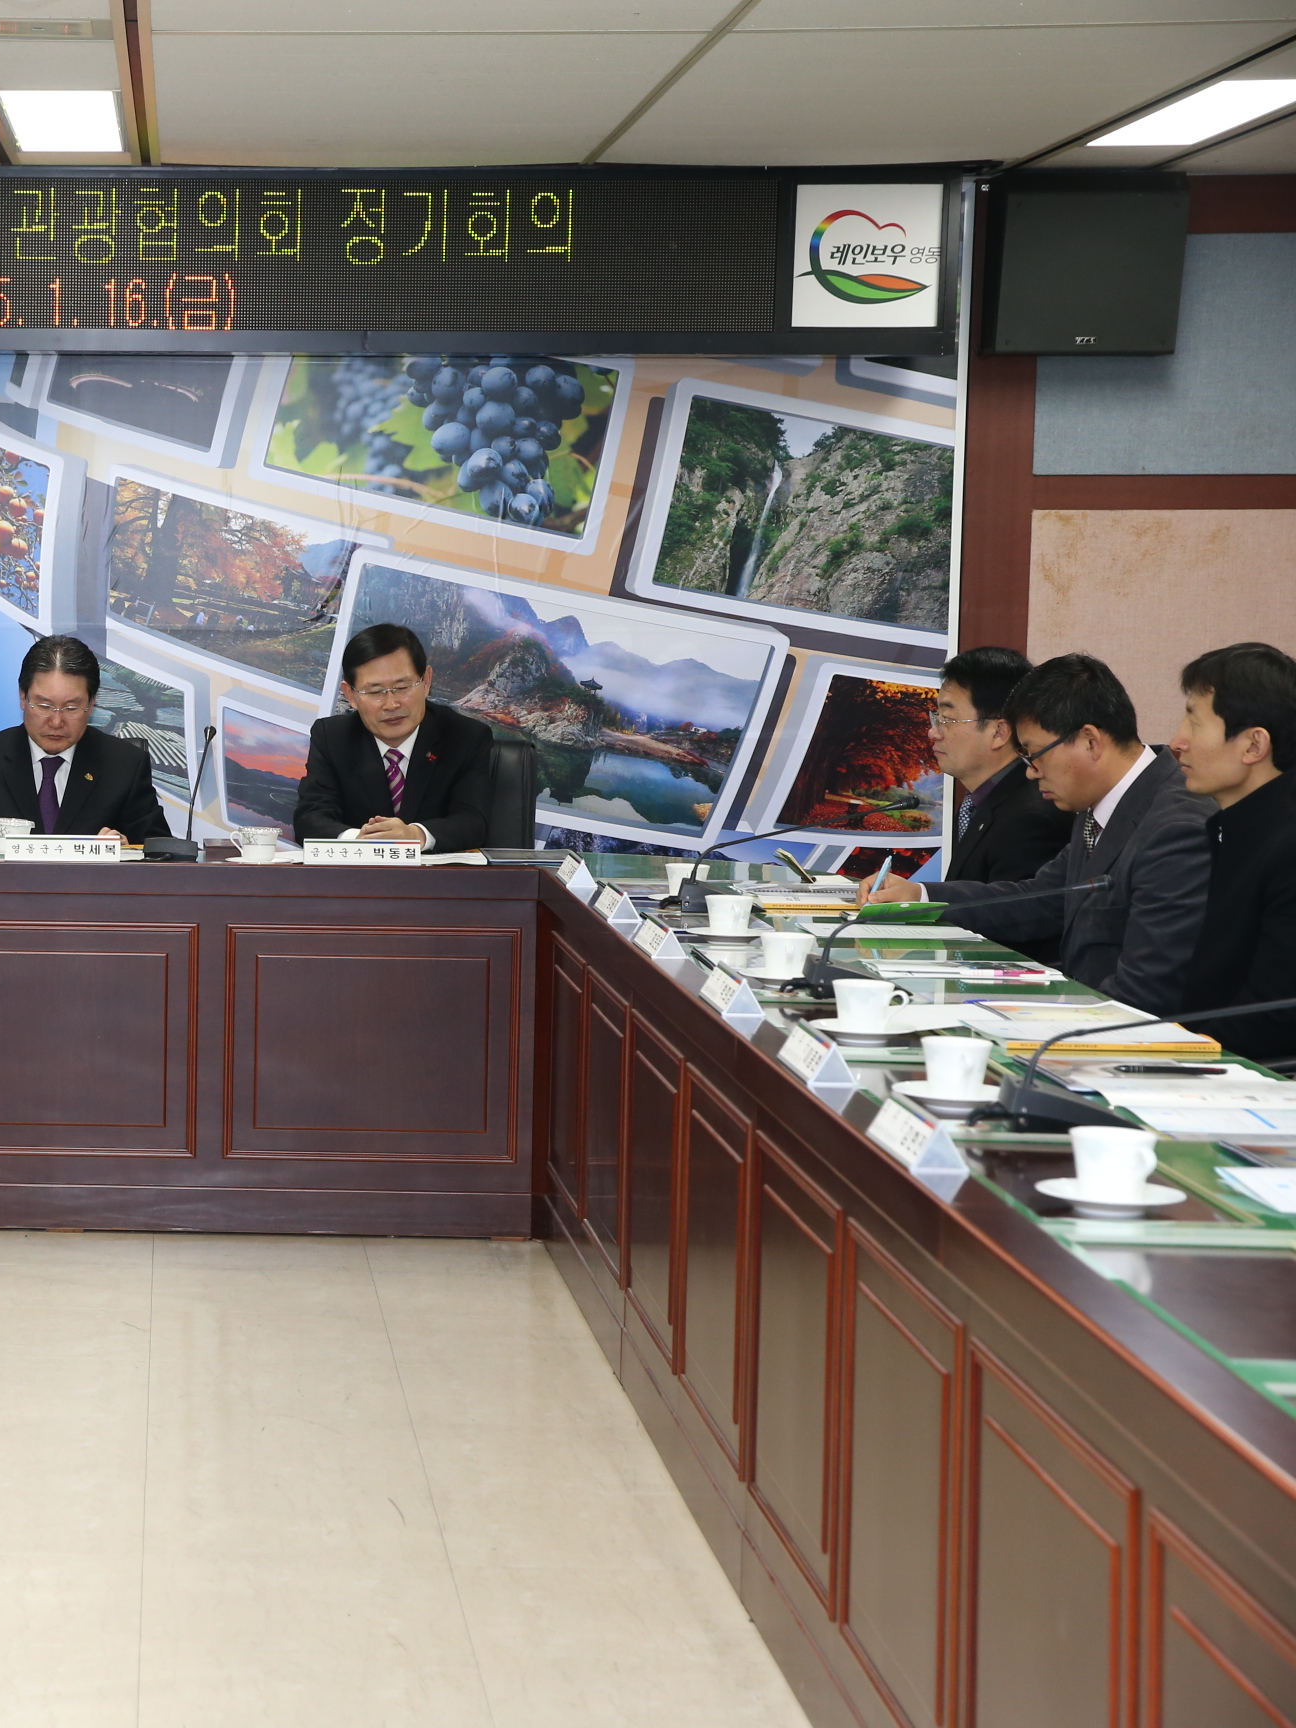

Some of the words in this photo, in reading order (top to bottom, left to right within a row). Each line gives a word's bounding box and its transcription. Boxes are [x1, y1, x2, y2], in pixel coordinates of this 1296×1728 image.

[10, 188, 302, 264] 관광협의회
[342, 188, 573, 265] 정기회의
[829, 243, 907, 266] 레인보우
[909, 245, 941, 265] 영동
[48, 280, 78, 325] 1.
[73, 844, 116, 856] 박세복
[373, 847, 416, 860] 박동철
